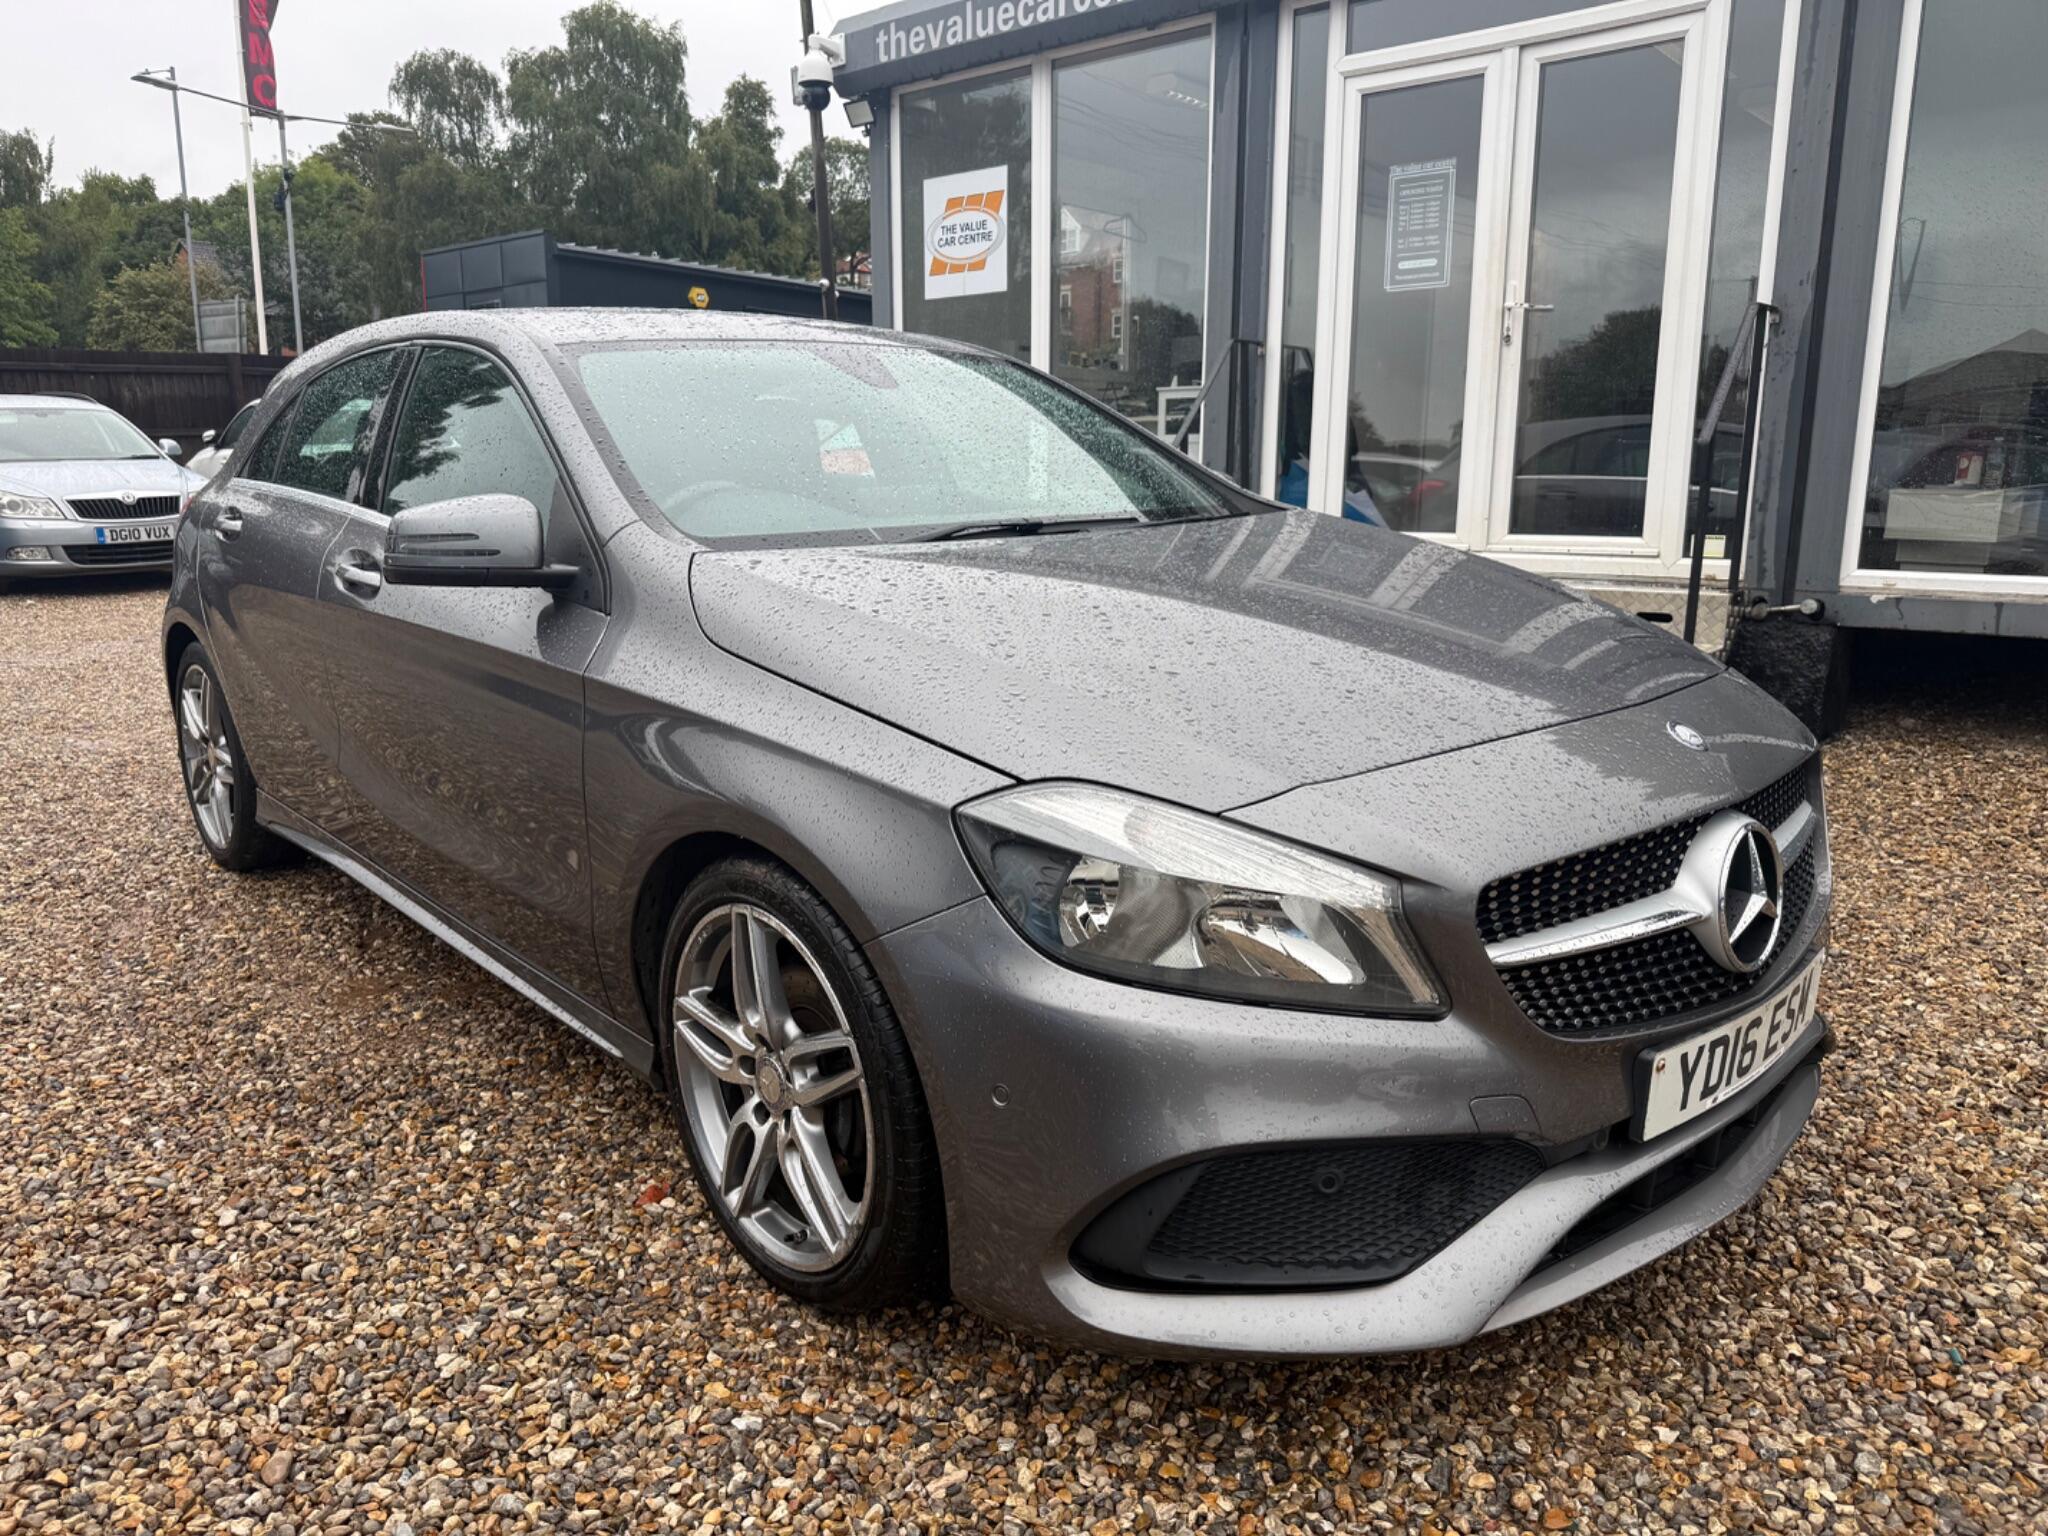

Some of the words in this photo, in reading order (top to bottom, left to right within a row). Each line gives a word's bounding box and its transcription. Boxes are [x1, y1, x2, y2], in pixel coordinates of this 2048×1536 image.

[941, 223, 957, 236] THE
[959, 219, 988, 233] VALUE
[937, 235, 956, 248] CAR
[957, 231, 993, 246] CENTRE
[109, 527, 141, 542] DG10
[144, 524, 171, 539] VUX
[1680, 1015, 1763, 1112] YD16
